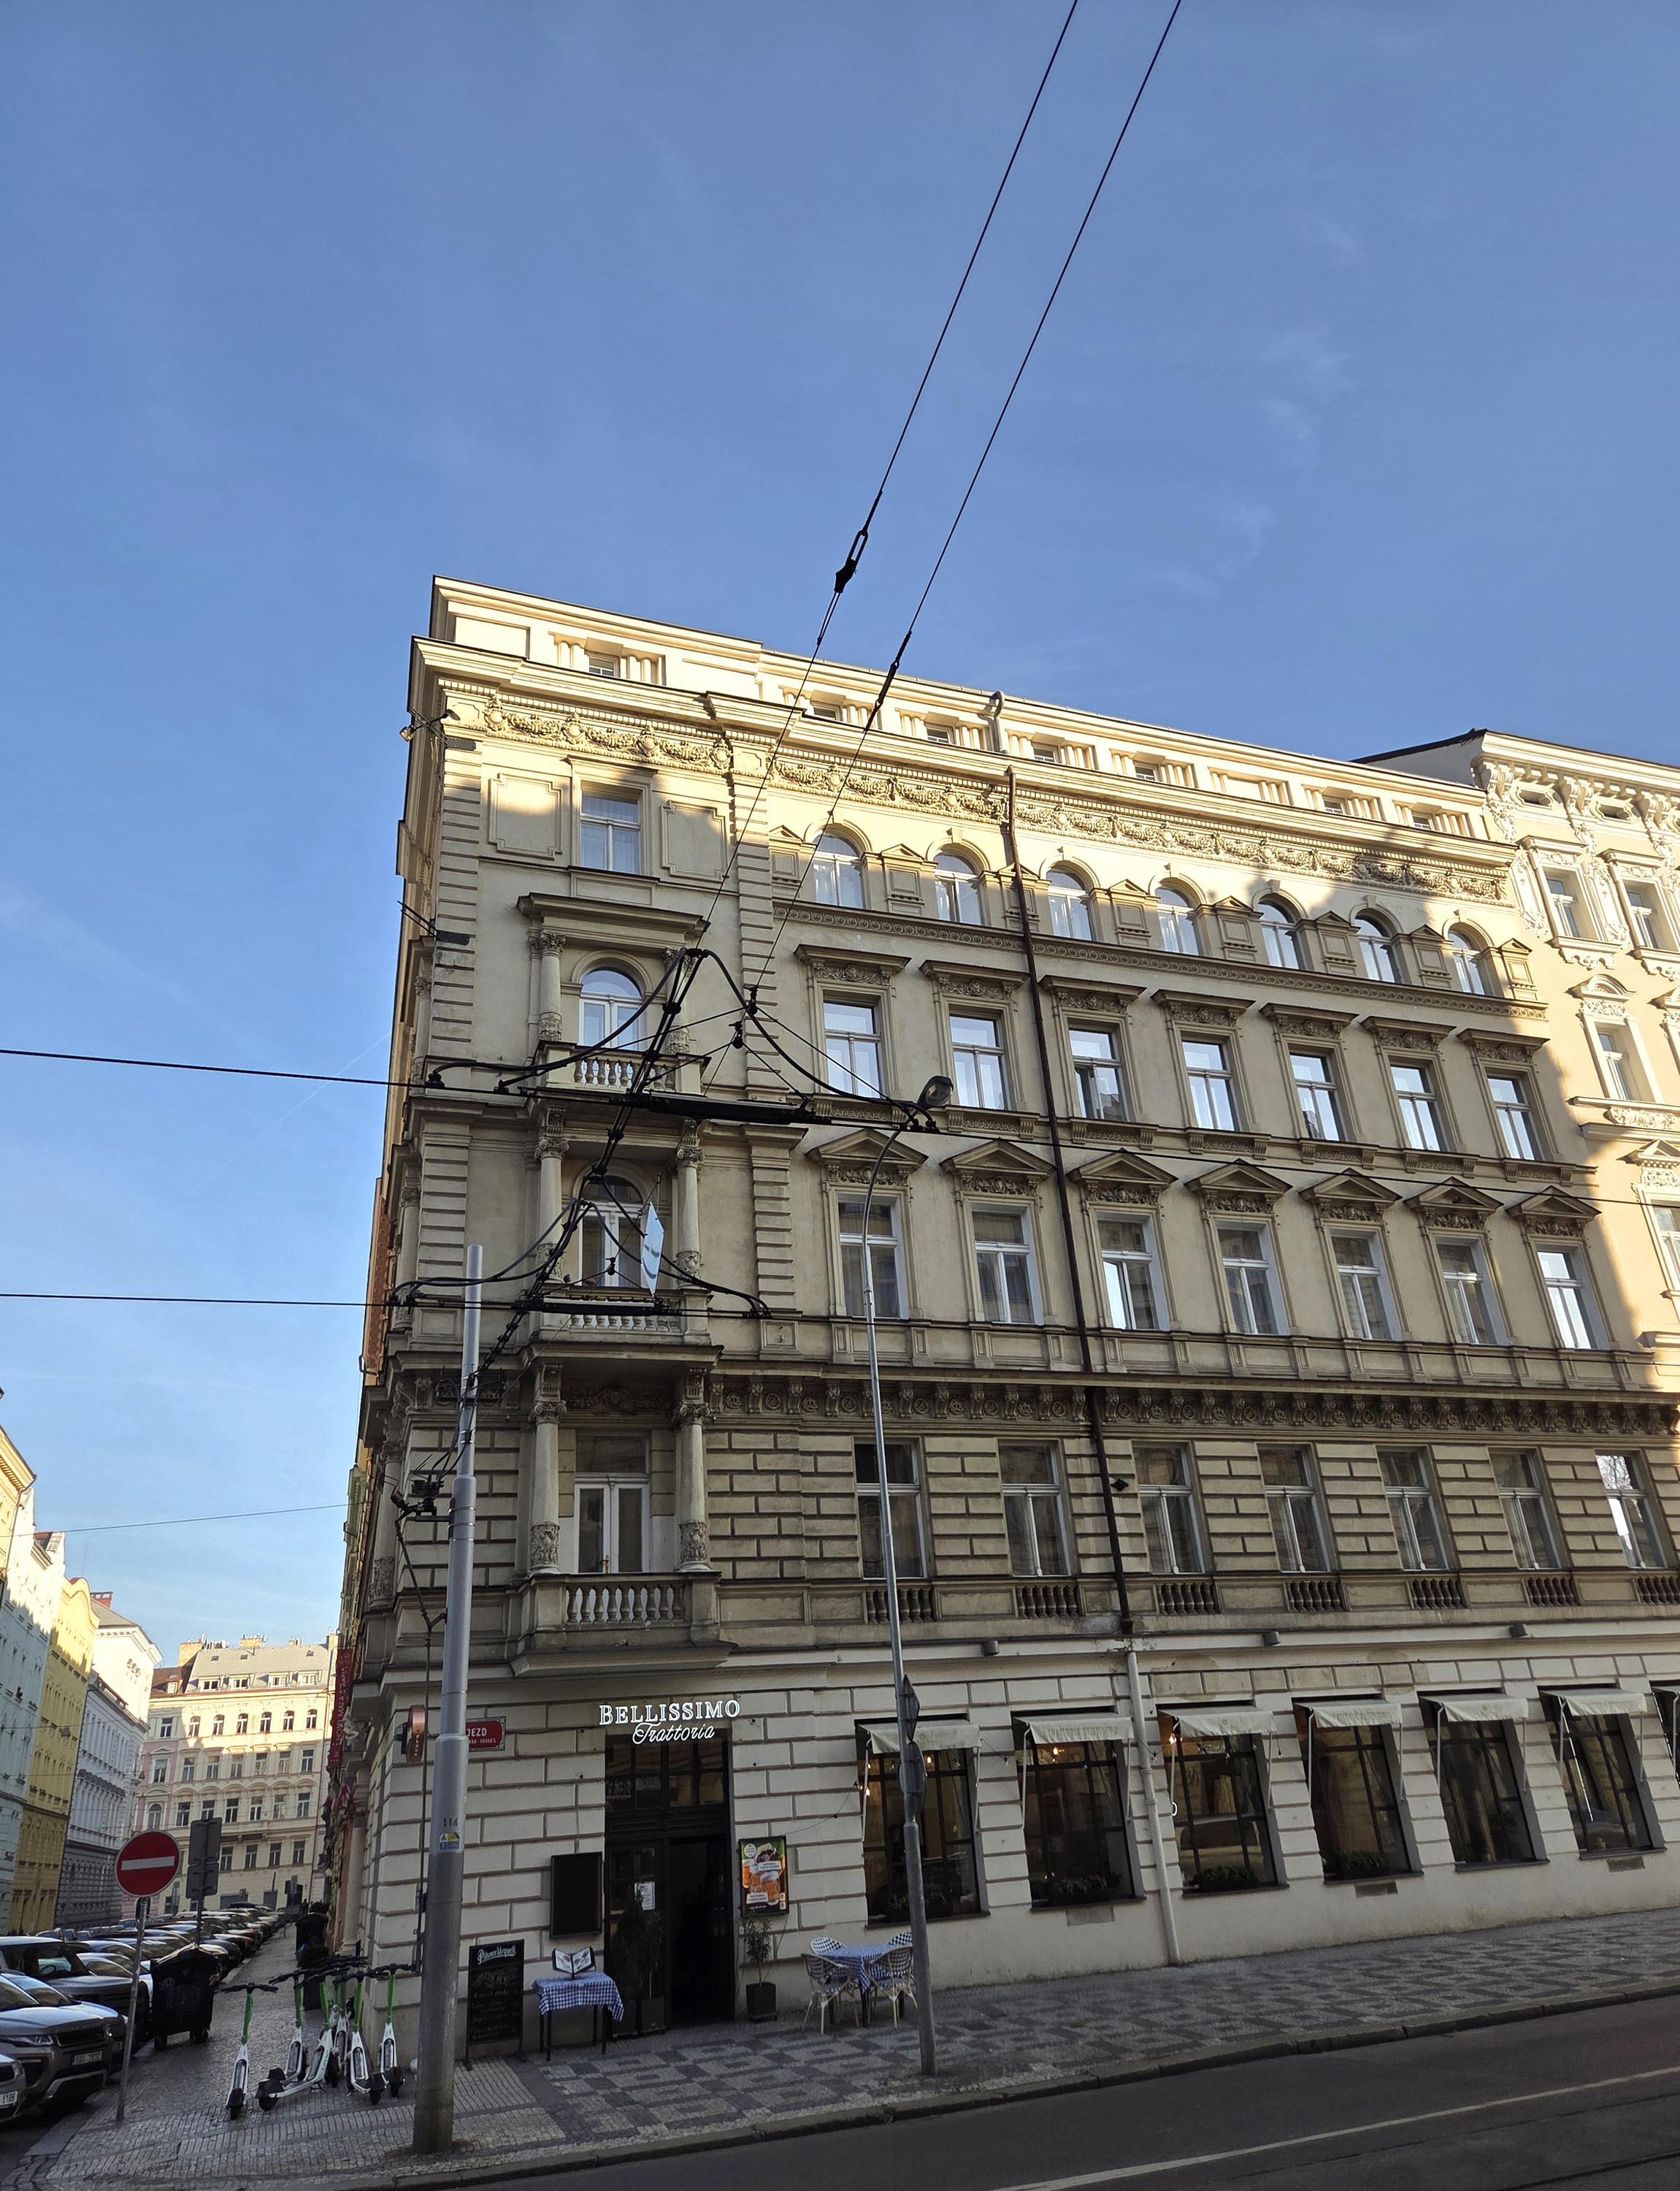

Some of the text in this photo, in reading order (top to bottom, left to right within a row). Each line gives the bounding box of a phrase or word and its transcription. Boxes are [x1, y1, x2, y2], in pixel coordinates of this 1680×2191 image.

[599, 1699, 740, 1725] BELLISSIMO
[467, 1727, 487, 1737] JEZD
[632, 1721, 716, 1745] Trattoria
[444, 1817, 458, 1827] 114
